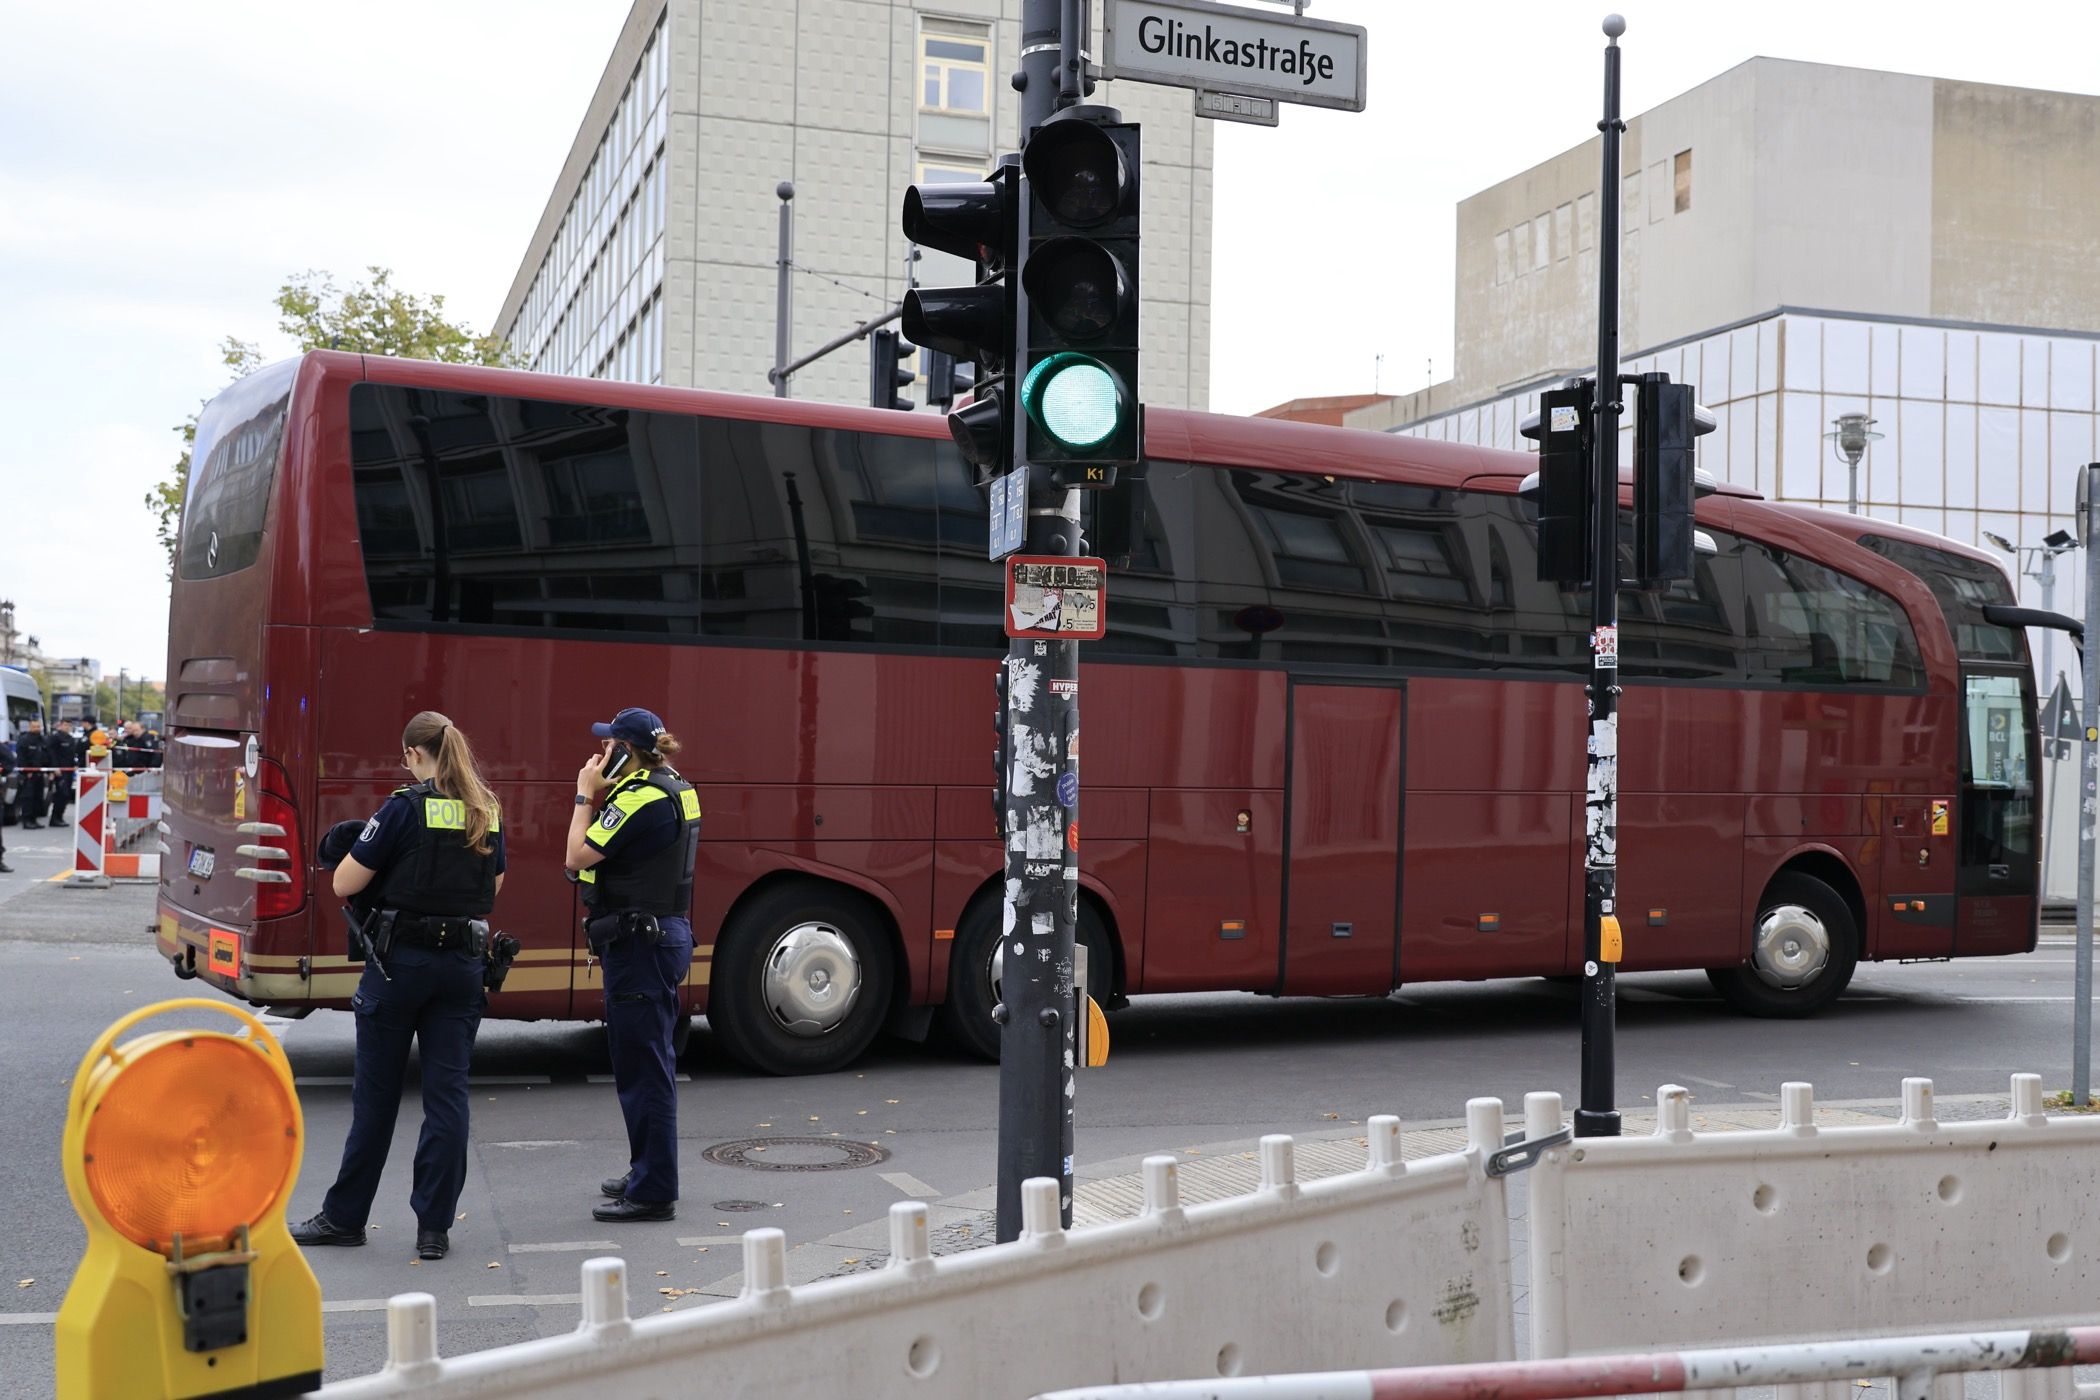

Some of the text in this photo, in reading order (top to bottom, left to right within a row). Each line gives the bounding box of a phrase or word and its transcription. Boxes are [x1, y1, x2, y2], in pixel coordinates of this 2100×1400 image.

[1138, 16, 1334, 86] Glinkastraße
[1087, 467, 1104, 480] K1
[1988, 730, 2007, 743] BCL
[1992, 751, 2002, 781] GISTIK
